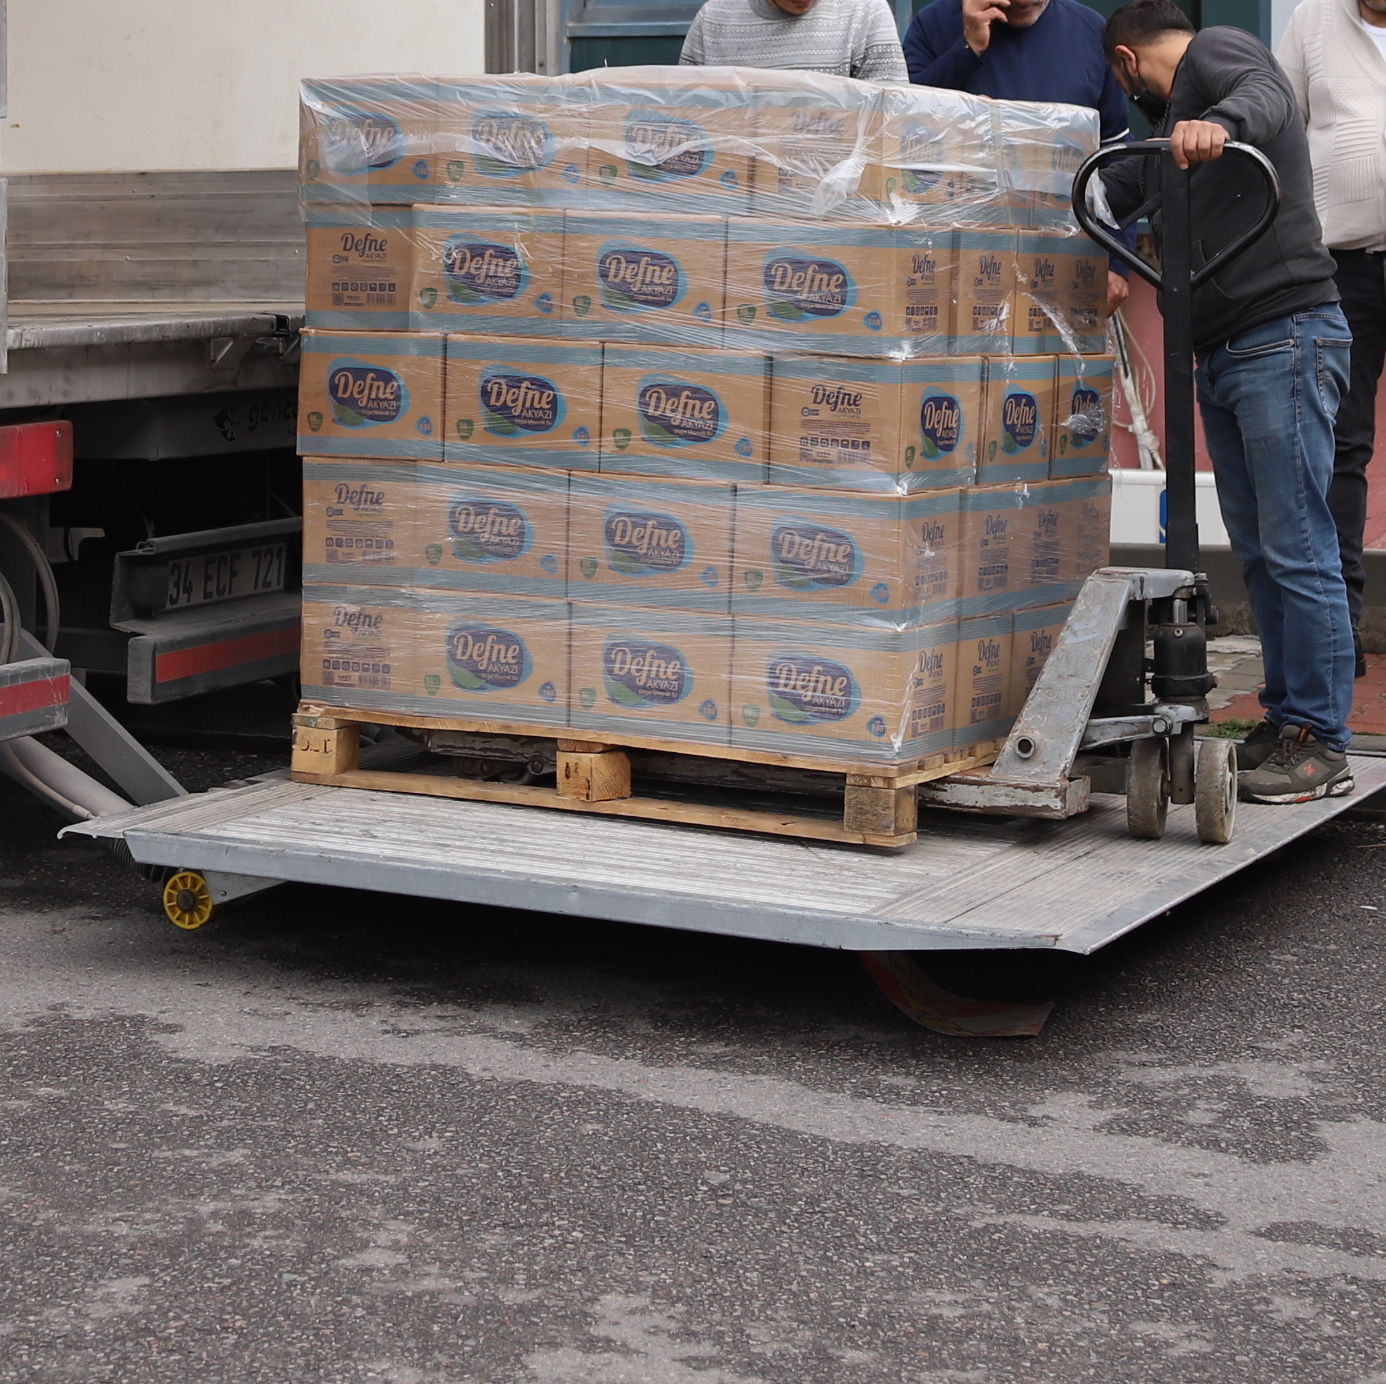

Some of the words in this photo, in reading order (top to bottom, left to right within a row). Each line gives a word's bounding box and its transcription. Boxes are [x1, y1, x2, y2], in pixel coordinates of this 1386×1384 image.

[341, 233, 388, 258] Defne
[450, 248, 520, 284] Defne
[606, 255, 674, 292] Defne
[912, 254, 937, 277] Defne
[979, 254, 1002, 278] Defne
[771, 262, 844, 301] Defne
[808, 292, 842, 304] AKYAZI
[334, 371, 398, 406] Defne
[487, 379, 555, 415] Defne
[811, 384, 863, 416] Defne
[367, 400, 397, 410] AKYAZI
[521, 409, 553, 419] AKYAZI
[645, 389, 716, 425] Defne
[837, 406, 862, 415] AKYAZI
[924, 401, 959, 437] Defne
[1005, 395, 1036, 432] Defne
[335, 483, 385, 511] Defne
[456, 505, 522, 542] Defne
[613, 517, 681, 554] Defne
[922, 520, 945, 545] Defne
[778, 530, 852, 569] Defne
[168, 562, 193, 606] 34
[203, 552, 241, 600] ECF
[252, 547, 283, 591] 721
[334, 606, 383, 635] Defne
[454, 633, 520, 670] Defne
[978, 639, 1001, 665] Defne
[1031, 630, 1053, 655] Defne
[487, 663, 519, 674] AKYAZI
[612, 647, 681, 686] Defne
[919, 649, 944, 675] Defne
[645, 680, 678, 691] AKYAZI
[776, 662, 848, 703] Defne
[811, 696, 845, 707] AKYAZI
